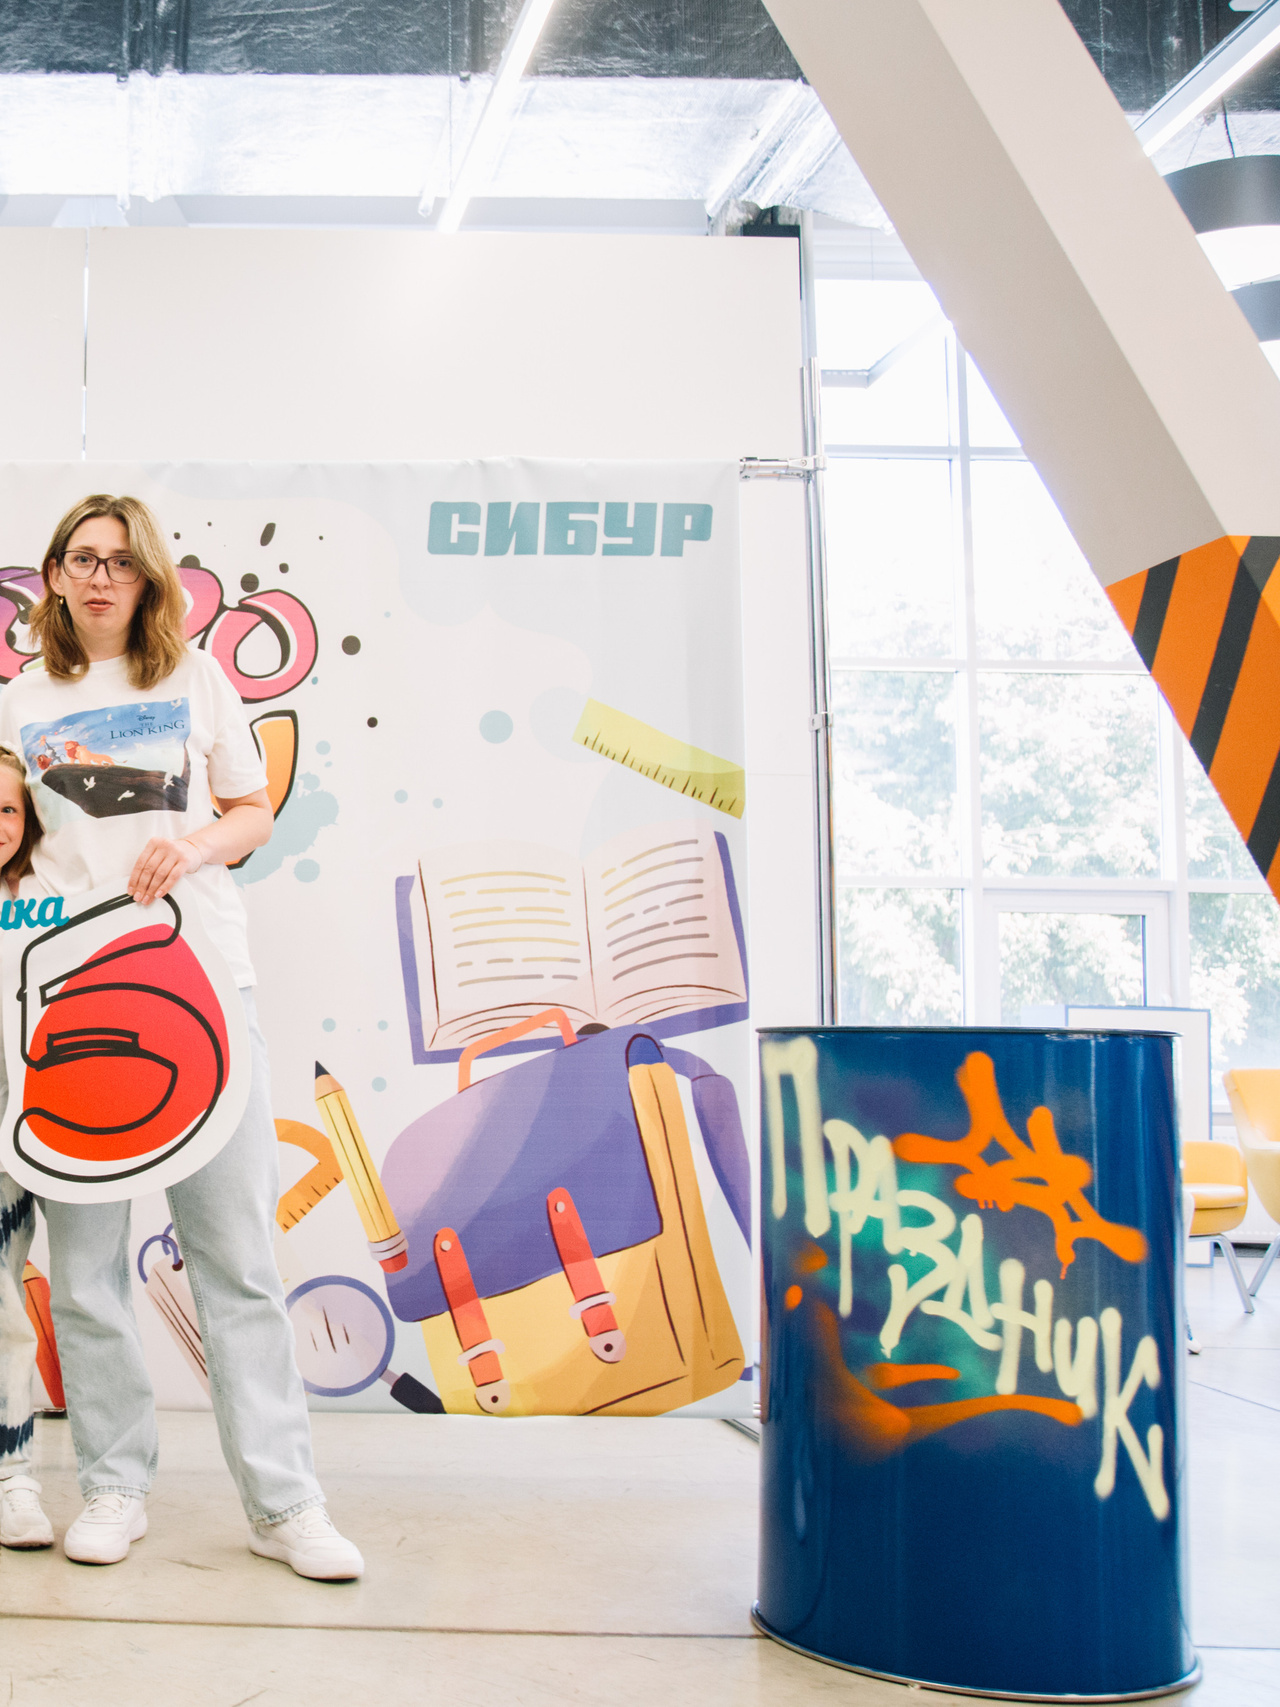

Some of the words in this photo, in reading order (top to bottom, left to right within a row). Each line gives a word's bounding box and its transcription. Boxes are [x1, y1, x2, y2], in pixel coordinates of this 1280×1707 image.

[427, 501, 713, 557] СИБУР
[110, 728, 144, 740] LION
[148, 719, 185, 735] KING
[14, 892, 230, 1183] 5
